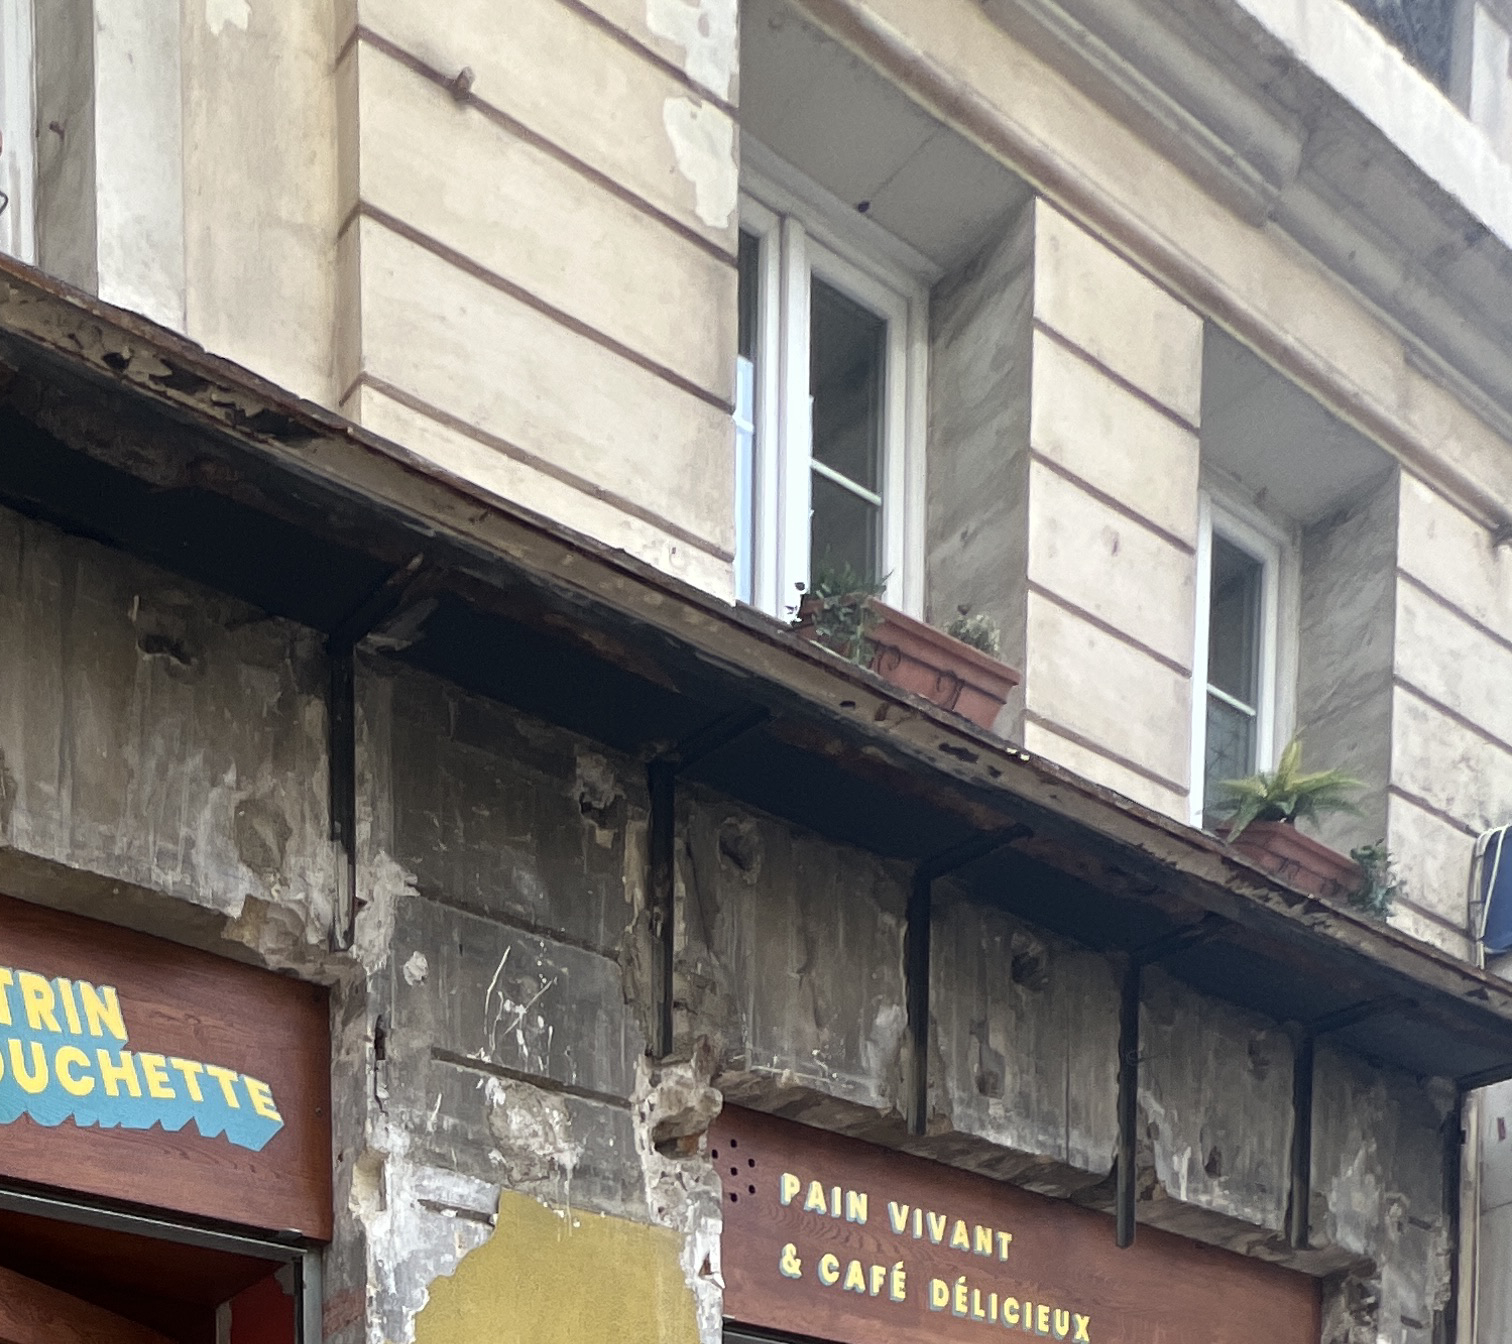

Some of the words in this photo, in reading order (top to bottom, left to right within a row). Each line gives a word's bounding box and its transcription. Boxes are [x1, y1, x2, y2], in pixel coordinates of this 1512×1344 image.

[780, 1172, 868, 1225] PAIN
[888, 1202, 1013, 1262] VIVANT
[779, 1243, 802, 1279] &
[817, 1253, 907, 1302] CAFÉ
[929, 1275, 1091, 1344] DÉLICIEUX
